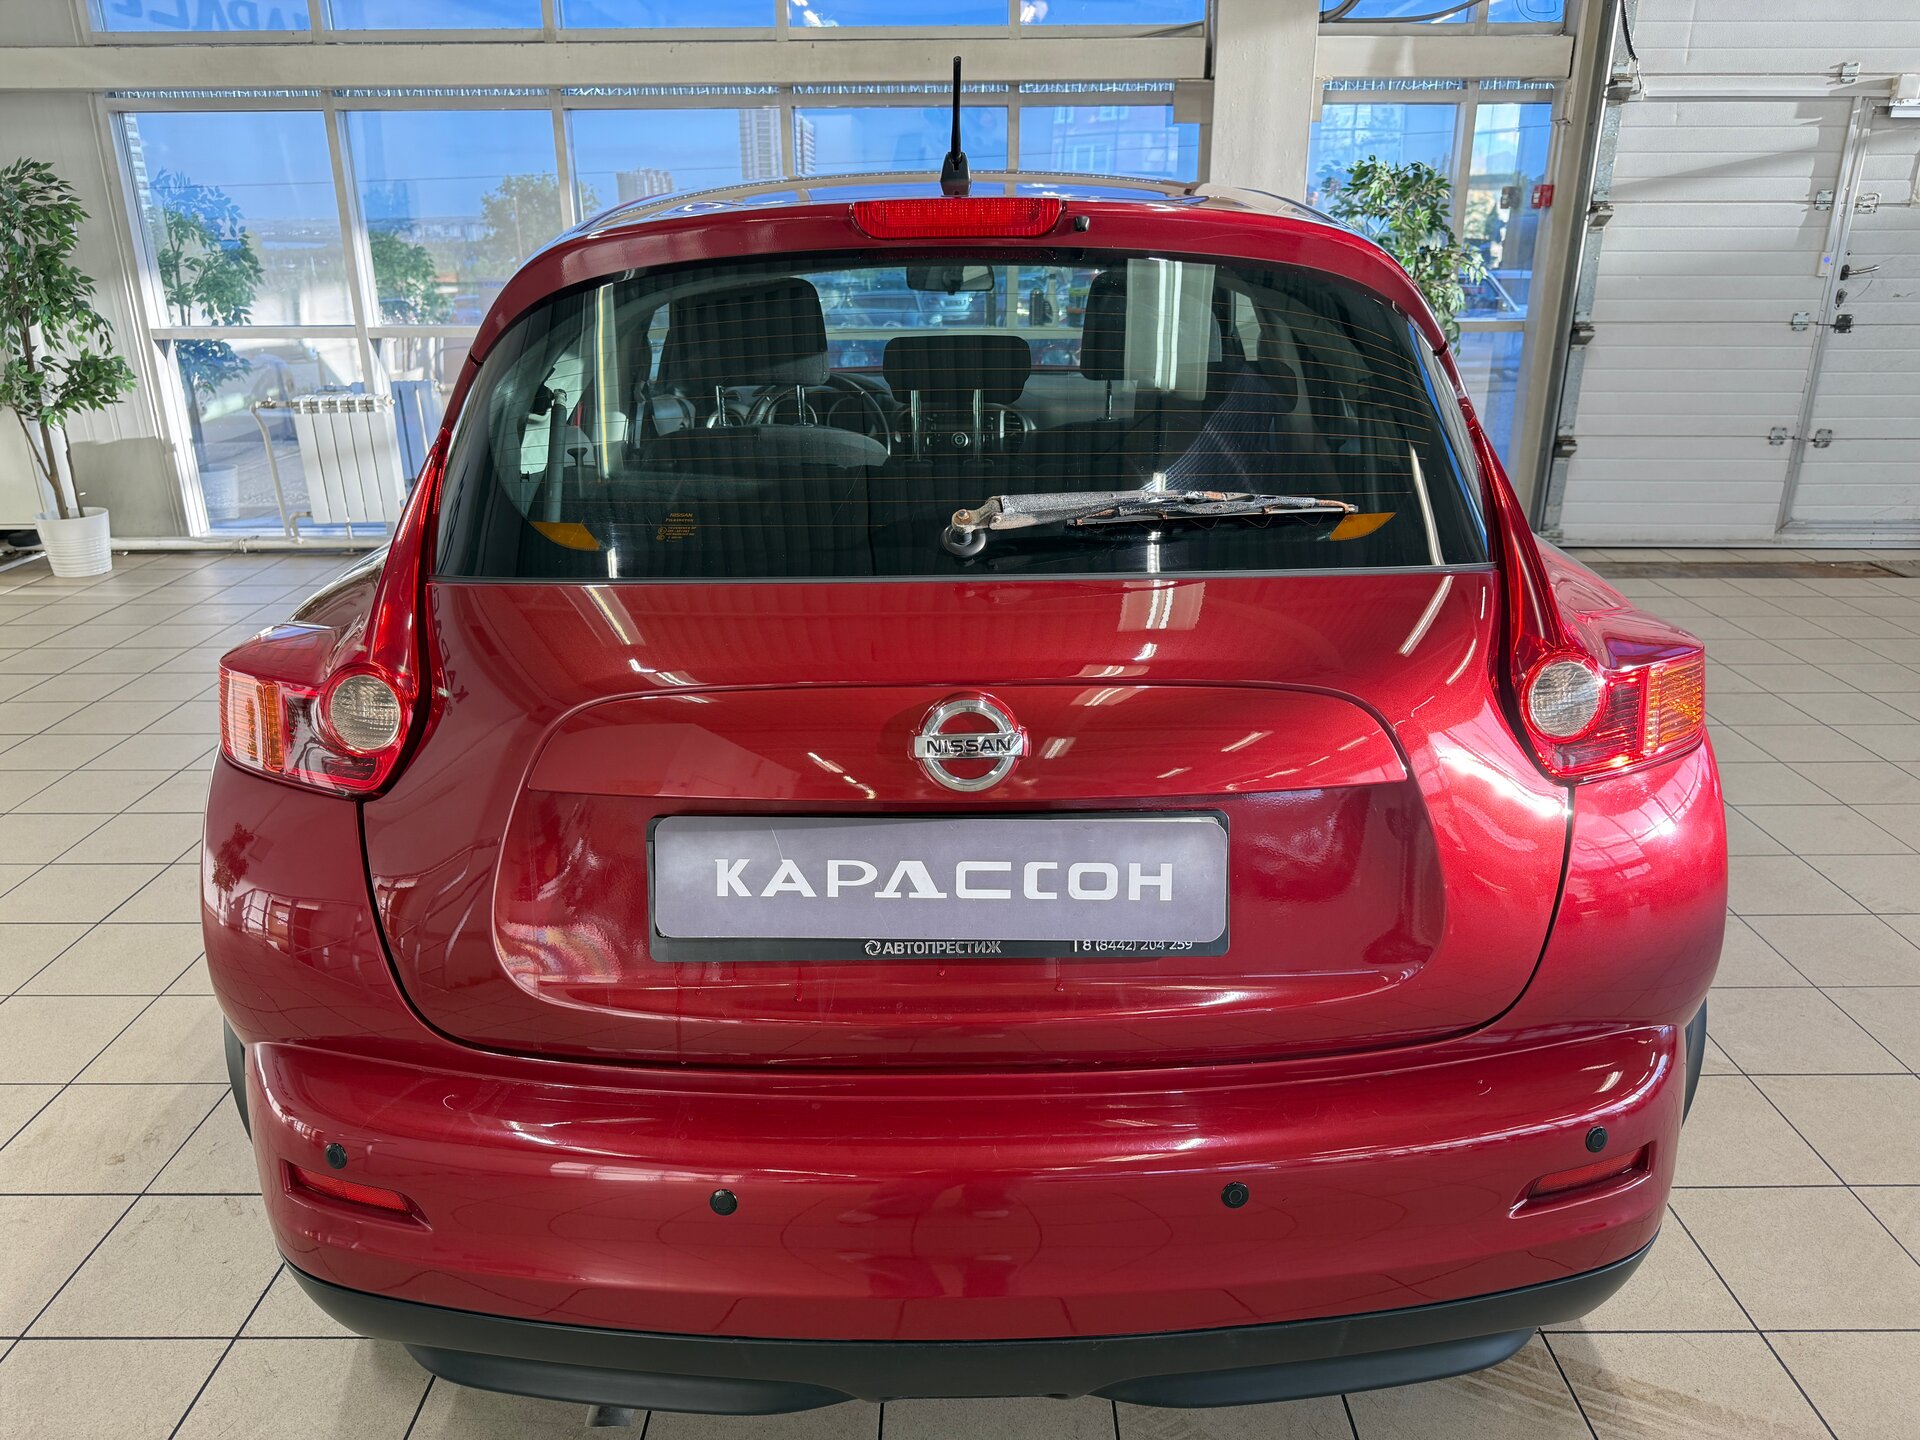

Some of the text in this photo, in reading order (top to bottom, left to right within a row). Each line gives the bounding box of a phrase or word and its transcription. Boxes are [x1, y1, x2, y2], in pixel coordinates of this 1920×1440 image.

[926, 738, 1012, 754] NISSAN
[882, 940, 1002, 955] АВТОПРЕСТИЖ
[1095, 940, 1137, 952] (8442)
[1140, 940, 1165, 951] 204
[1168, 940, 1193, 950] 259
